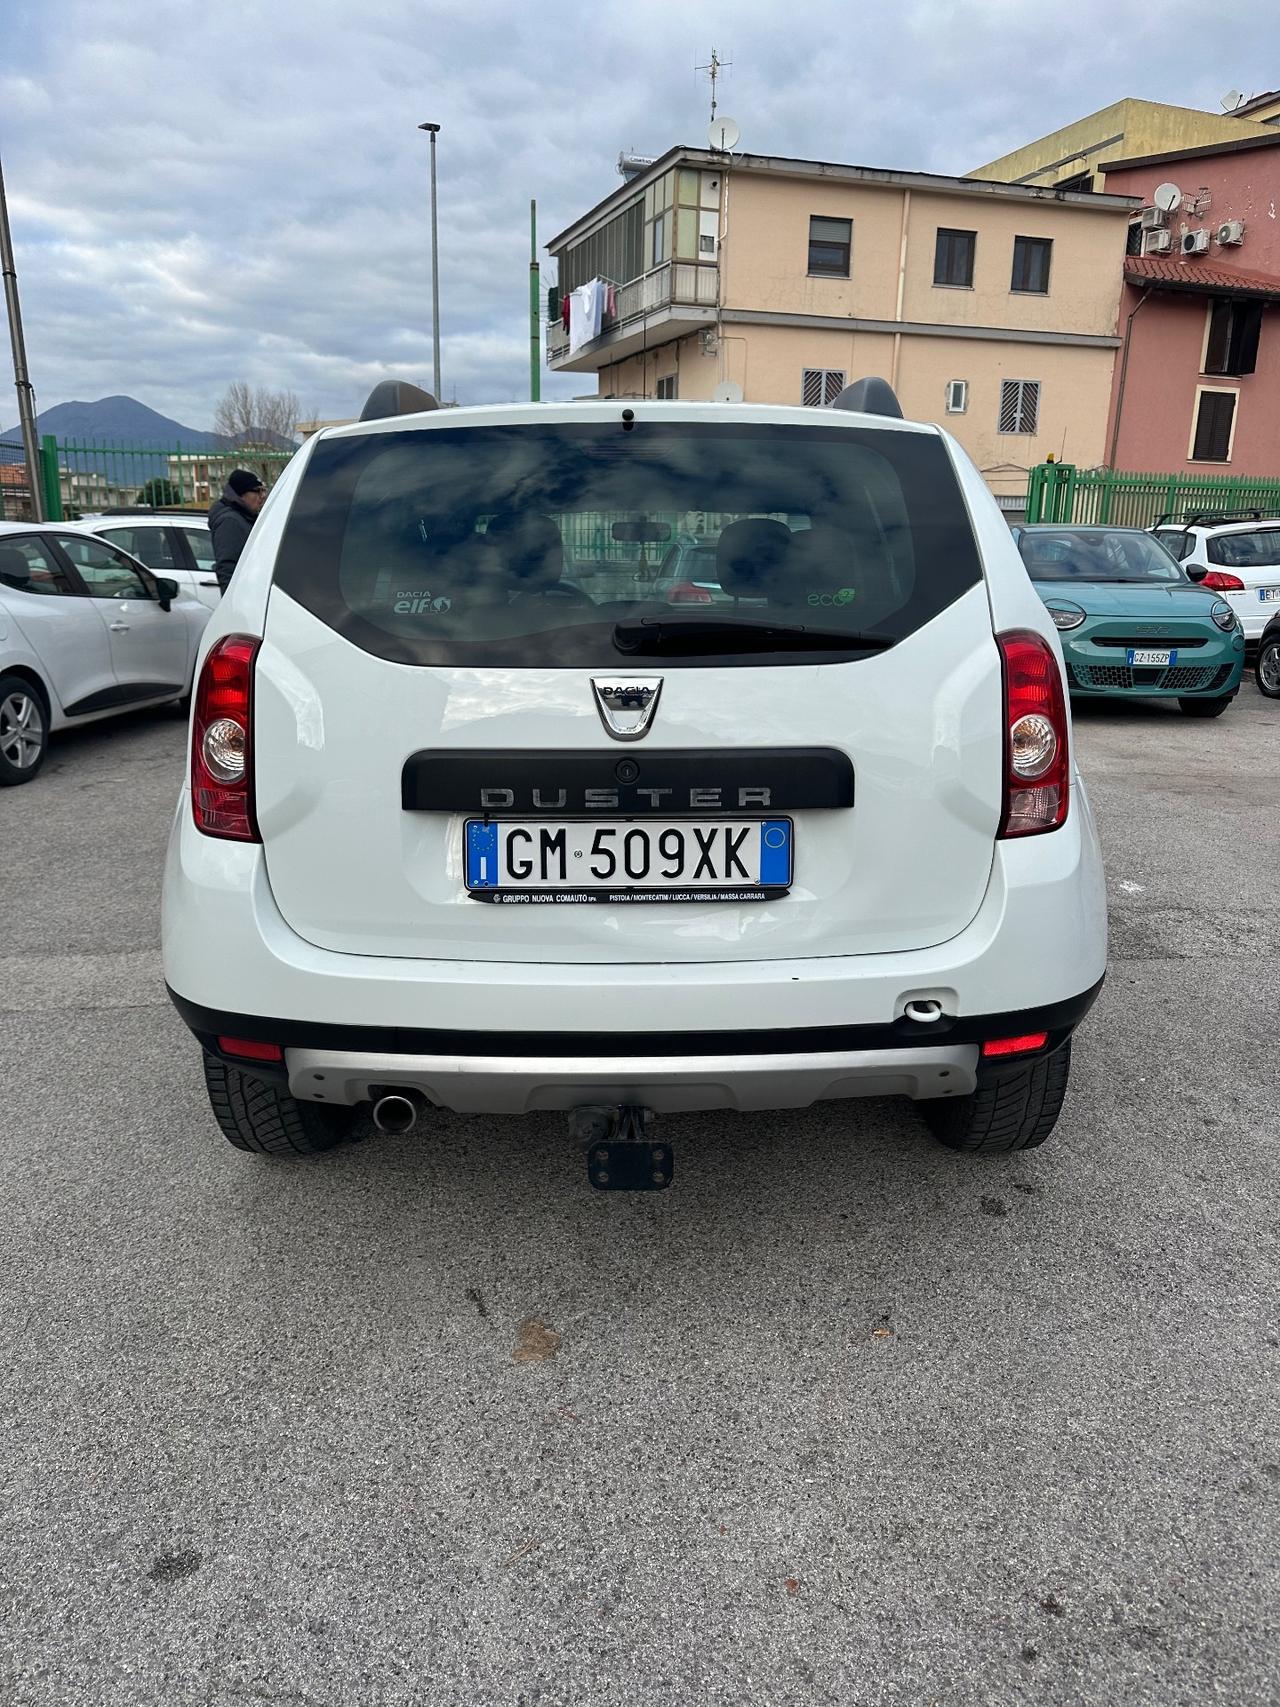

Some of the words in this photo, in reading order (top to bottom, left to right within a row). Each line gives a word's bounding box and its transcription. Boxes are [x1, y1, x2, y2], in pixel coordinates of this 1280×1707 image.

[396, 590, 431, 599] DACIA
[393, 599, 431, 614] elf
[603, 686, 650, 695] DACIA
[480, 788, 771, 808] DUSTER
[506, 827, 567, 880] GM
[590, 827, 751, 880] 509XK
[502, 895, 529, 903] GRUPPO
[532, 894, 554, 902] NUOVA
[556, 894, 588, 903] COMAUTO
[672, 893, 690, 901] LUCCA
[740, 892, 765, 900] CARRARA
